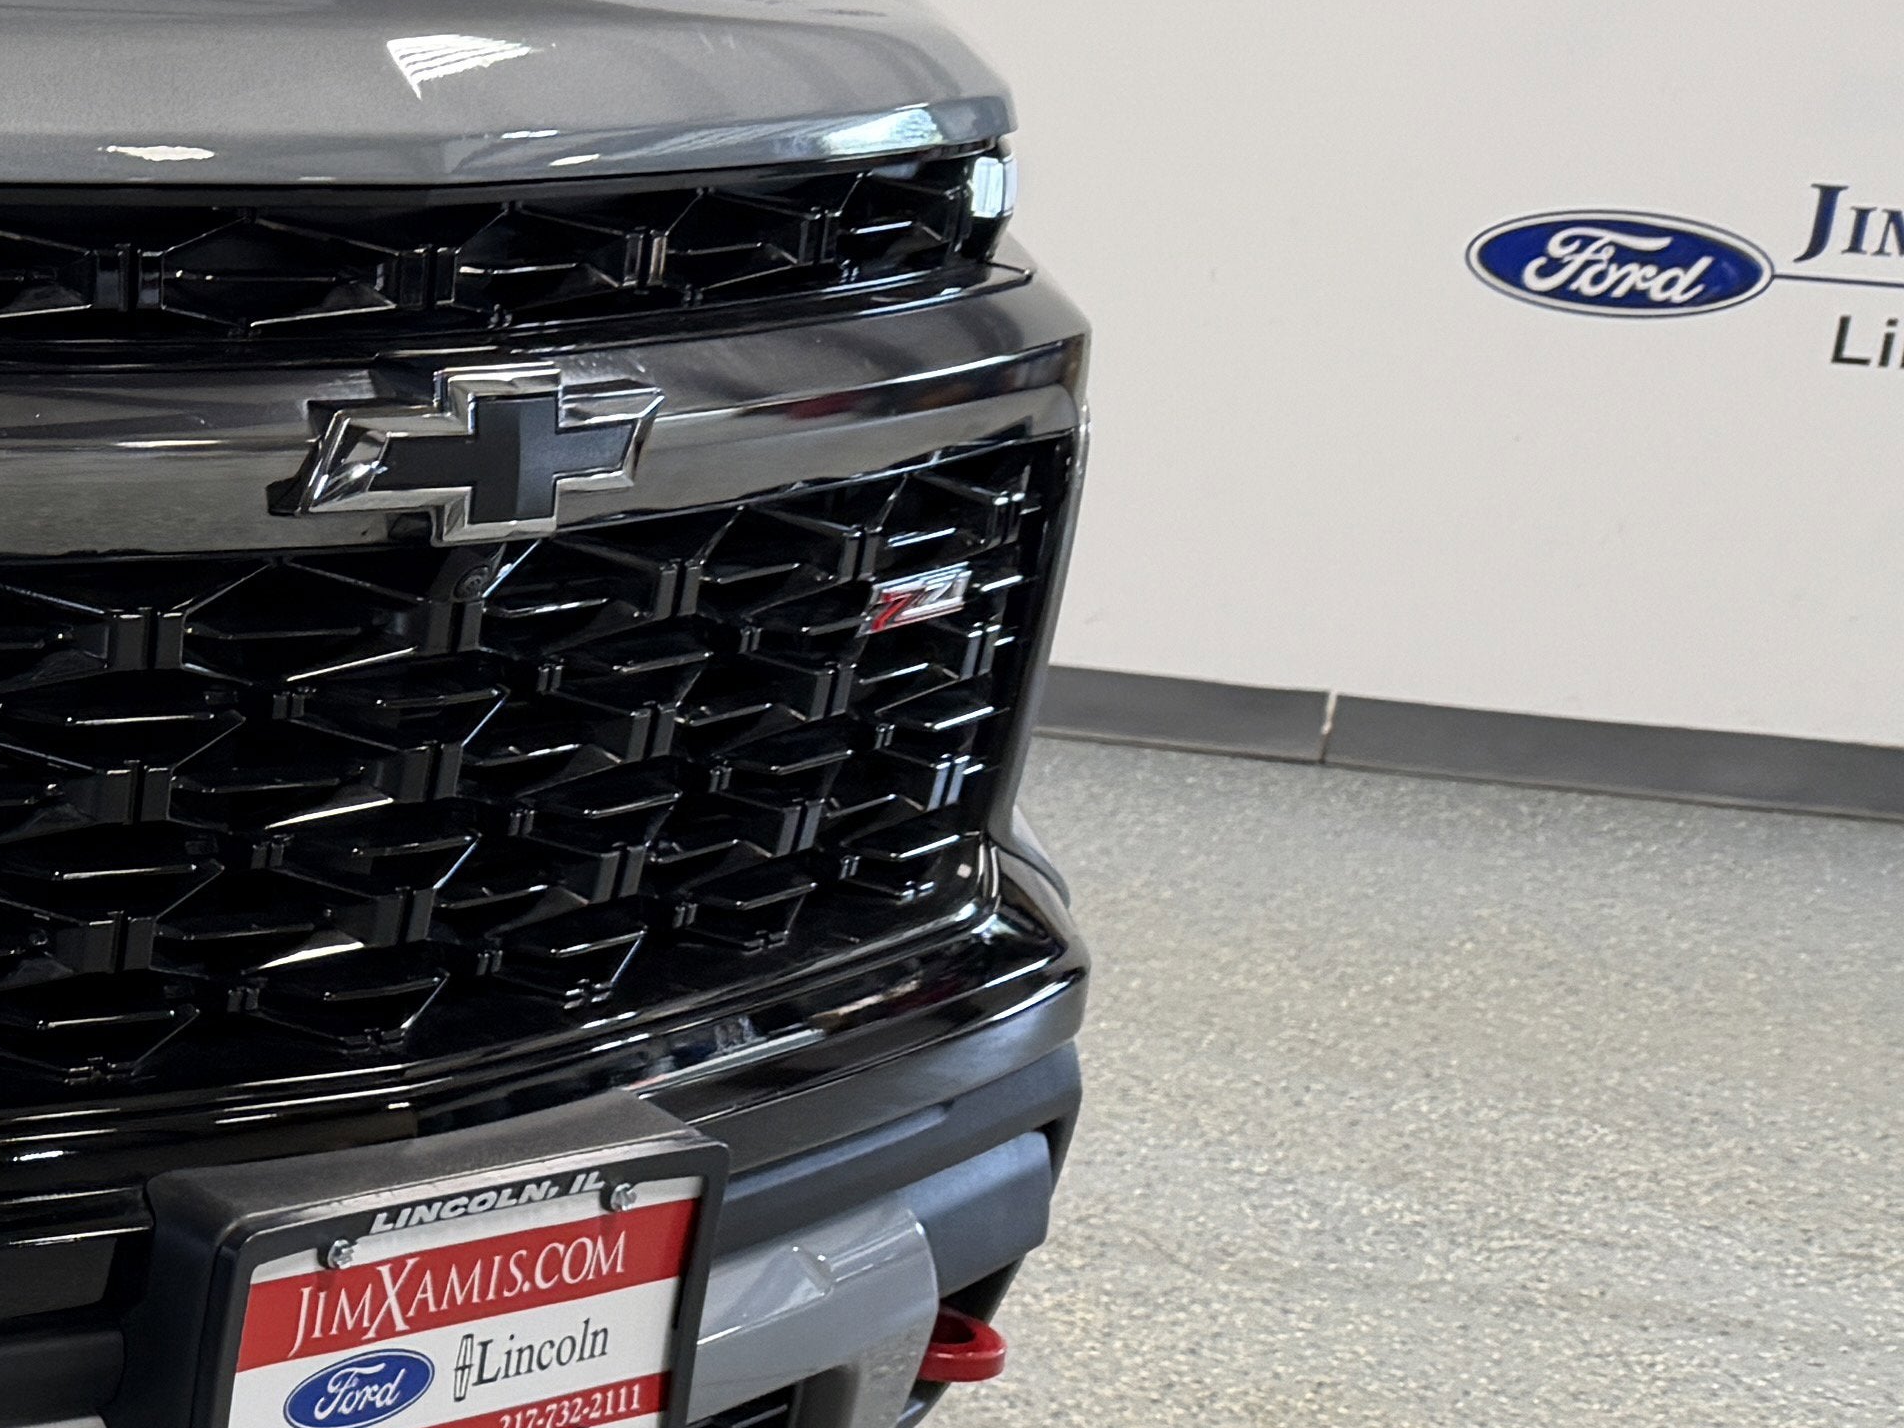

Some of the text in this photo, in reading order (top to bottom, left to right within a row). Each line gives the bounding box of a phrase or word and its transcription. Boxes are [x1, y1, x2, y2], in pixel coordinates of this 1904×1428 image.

[1523, 227, 1712, 304] Ford
[370, 1170, 604, 1233] LINCOLN, IL
[290, 1230, 627, 1357] JIMXAMIS.COM
[476, 1318, 609, 1386] Lincoln
[315, 1363, 403, 1421] Ford
